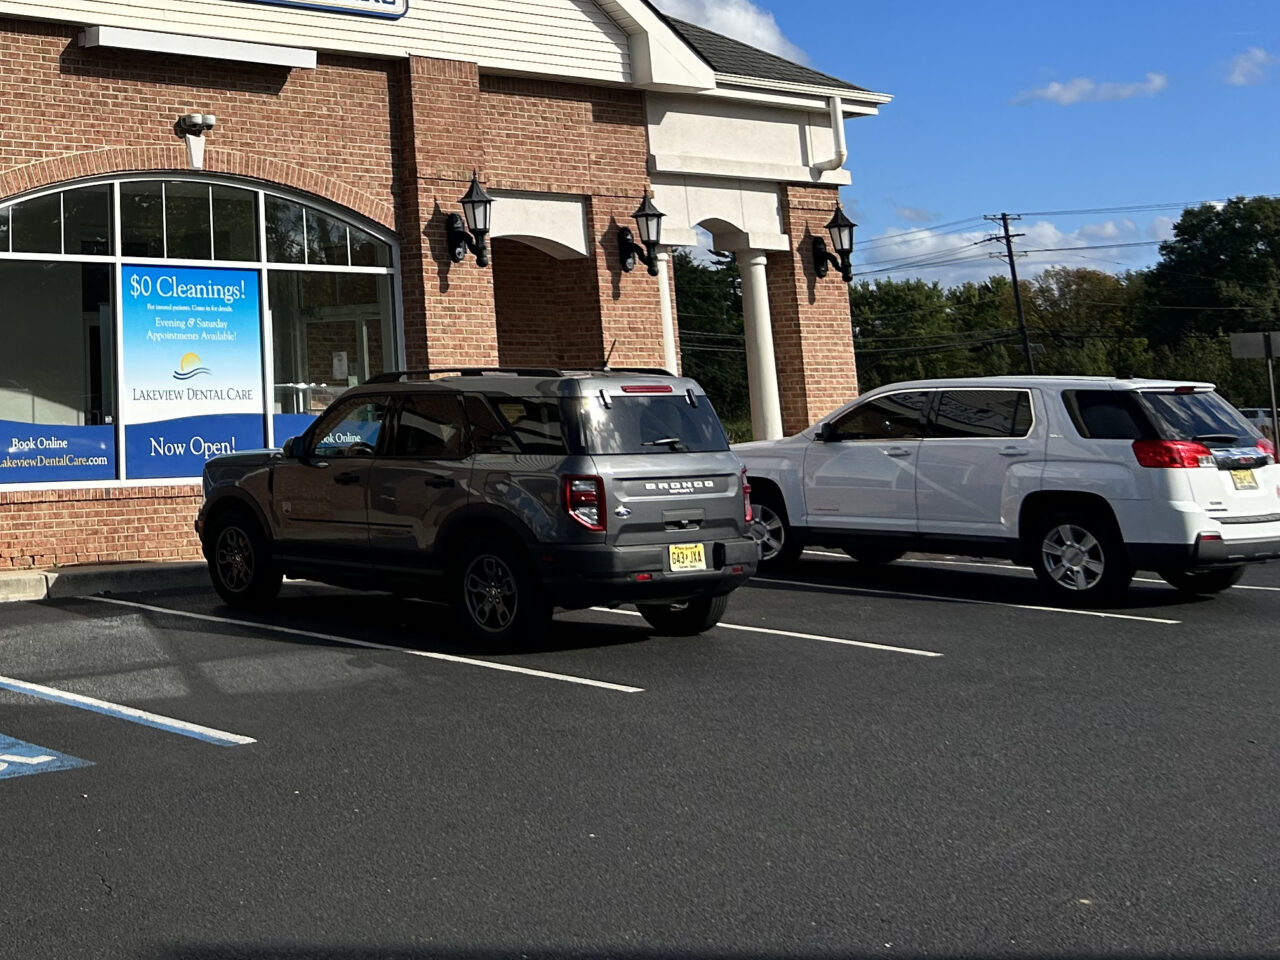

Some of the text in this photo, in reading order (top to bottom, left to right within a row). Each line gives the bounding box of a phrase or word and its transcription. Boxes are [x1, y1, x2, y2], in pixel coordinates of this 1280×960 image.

[130, 273, 246, 304] $0 Cleanings!
[155, 317, 186, 330] Evening
[196, 317, 228, 330] Saturday
[146, 329, 237, 342] Appointments Available!
[132, 387, 253, 401] LAKEVIEW DENTAL CARE
[11, 436, 68, 449] Book Online
[335, 431, 362, 443] Online
[149, 436, 236, 459] Now Open!
[645, 480, 714, 490] BRONCO
[672, 551, 685, 565] G43
